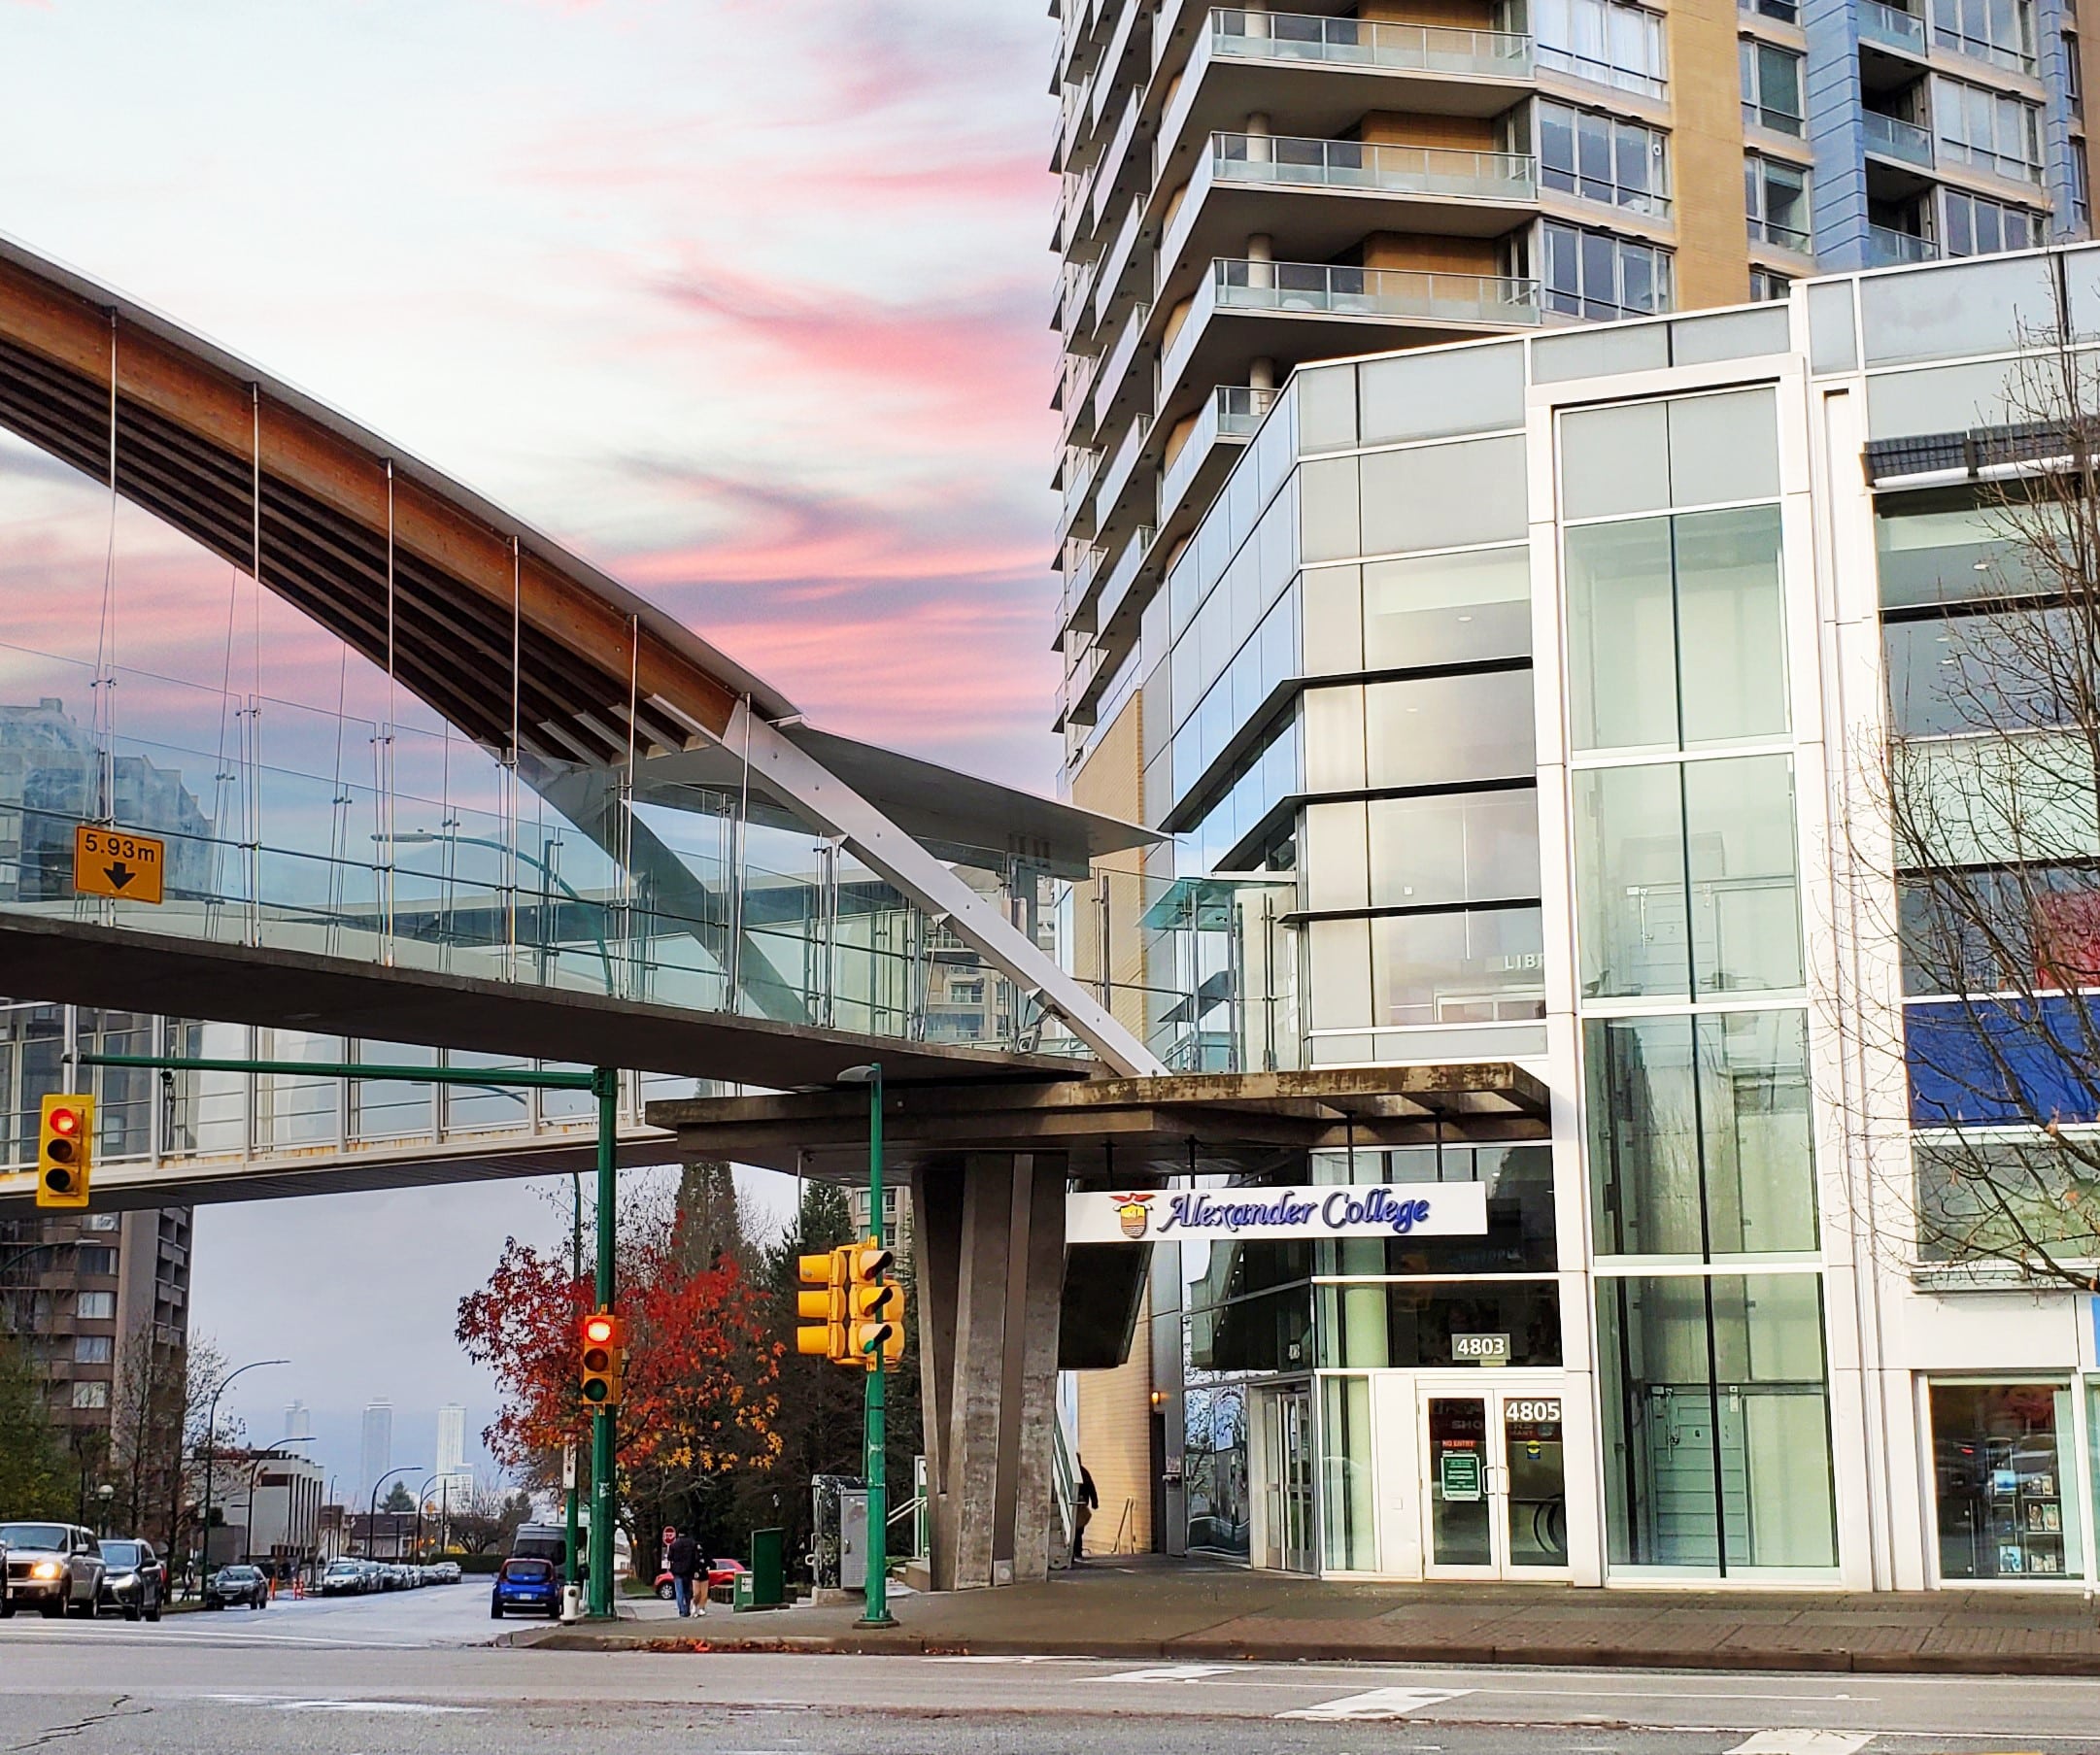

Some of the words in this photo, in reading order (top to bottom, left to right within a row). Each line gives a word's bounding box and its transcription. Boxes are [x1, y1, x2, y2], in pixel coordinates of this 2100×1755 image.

[85, 833, 154, 862] 5.93m
[1157, 1190, 1317, 1232] Alexander
[1322, 1188, 1430, 1233] College
[1457, 1337, 1505, 1355] 4803
[1506, 1401, 1560, 1422] 4805
